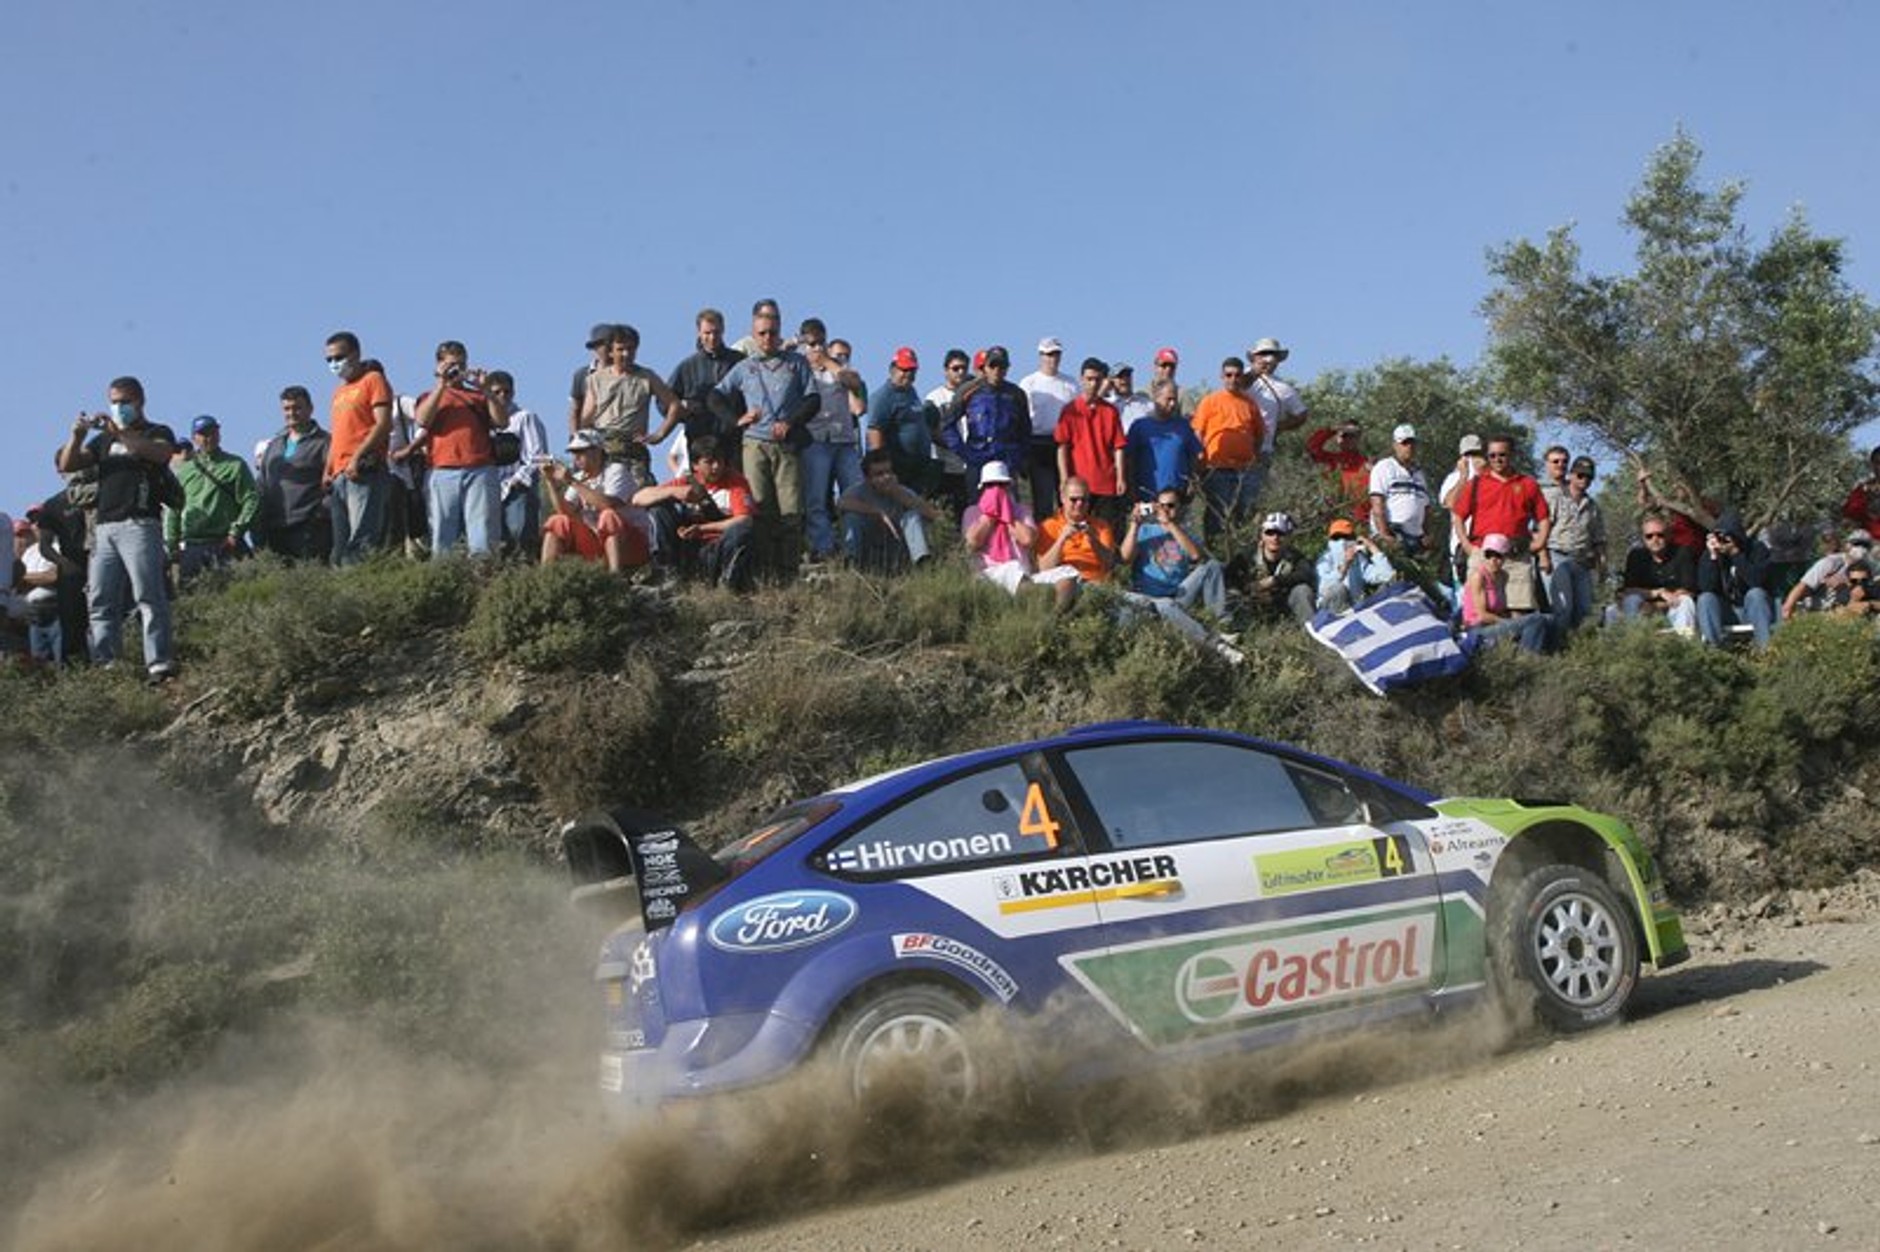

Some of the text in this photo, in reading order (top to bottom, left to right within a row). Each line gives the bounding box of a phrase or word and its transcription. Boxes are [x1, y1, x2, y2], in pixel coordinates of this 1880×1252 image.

[1019, 781, 1061, 848] 4
[858, 832, 1012, 870] Hirvonen
[1385, 835, 1404, 876] 4
[1019, 854, 1178, 897] KÄRCHER
[737, 900, 830, 944] Ford
[902, 935, 1016, 997] BFGoodrich
[1244, 924, 1420, 1007] Castrol
